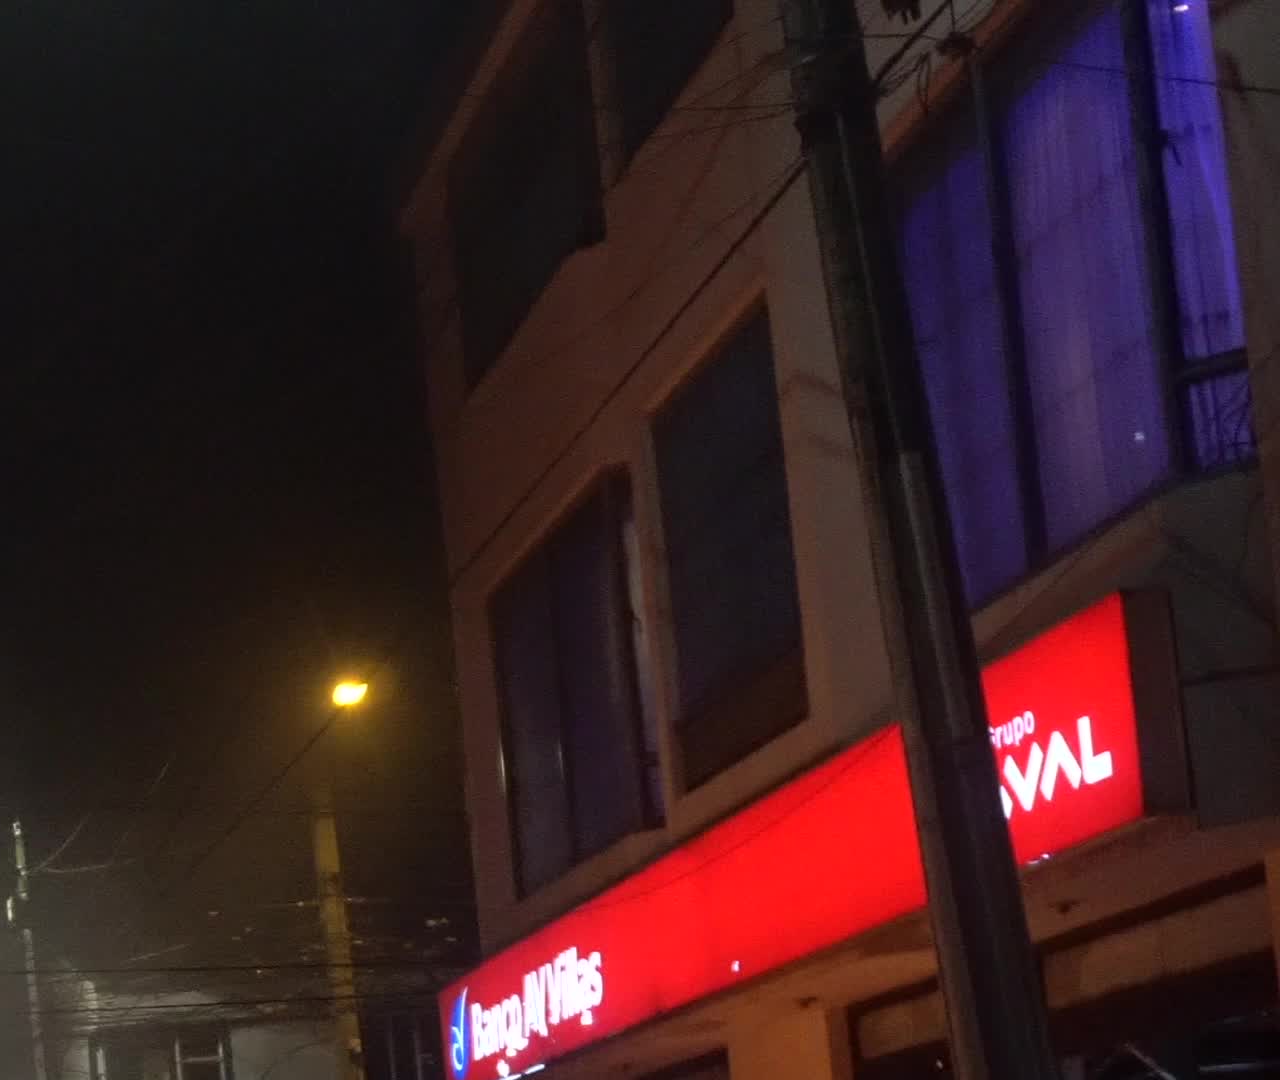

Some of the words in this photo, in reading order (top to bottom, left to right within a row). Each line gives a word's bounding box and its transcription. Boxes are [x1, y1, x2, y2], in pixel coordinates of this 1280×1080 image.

[999, 716, 1113, 820] VAL
[471, 994, 527, 1060] Banco
[545, 946, 603, 1024] Villas
